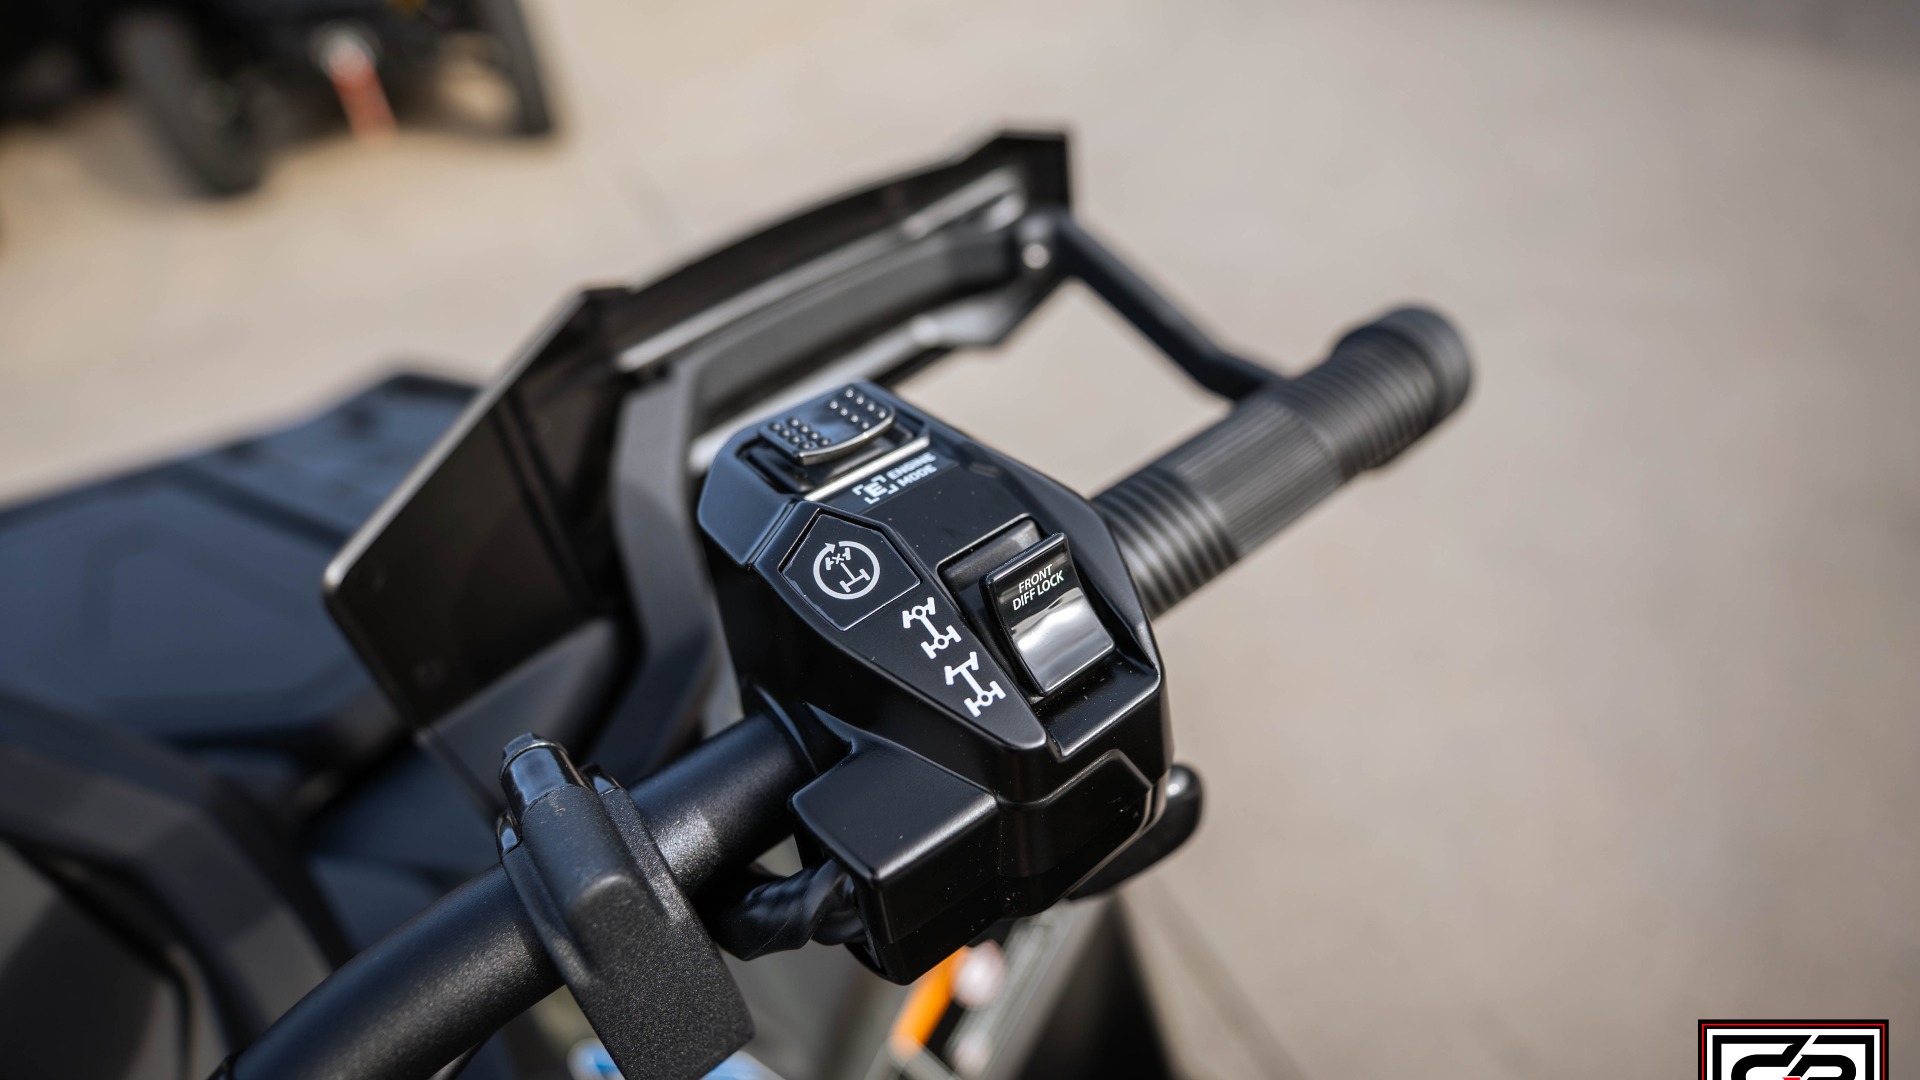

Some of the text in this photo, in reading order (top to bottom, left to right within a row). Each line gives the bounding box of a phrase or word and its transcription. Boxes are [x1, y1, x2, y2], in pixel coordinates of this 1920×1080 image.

[897, 463, 937, 487] MODE
[1012, 569, 1065, 611] DIFF LOCK
[1018, 563, 1053, 594] FRONT
